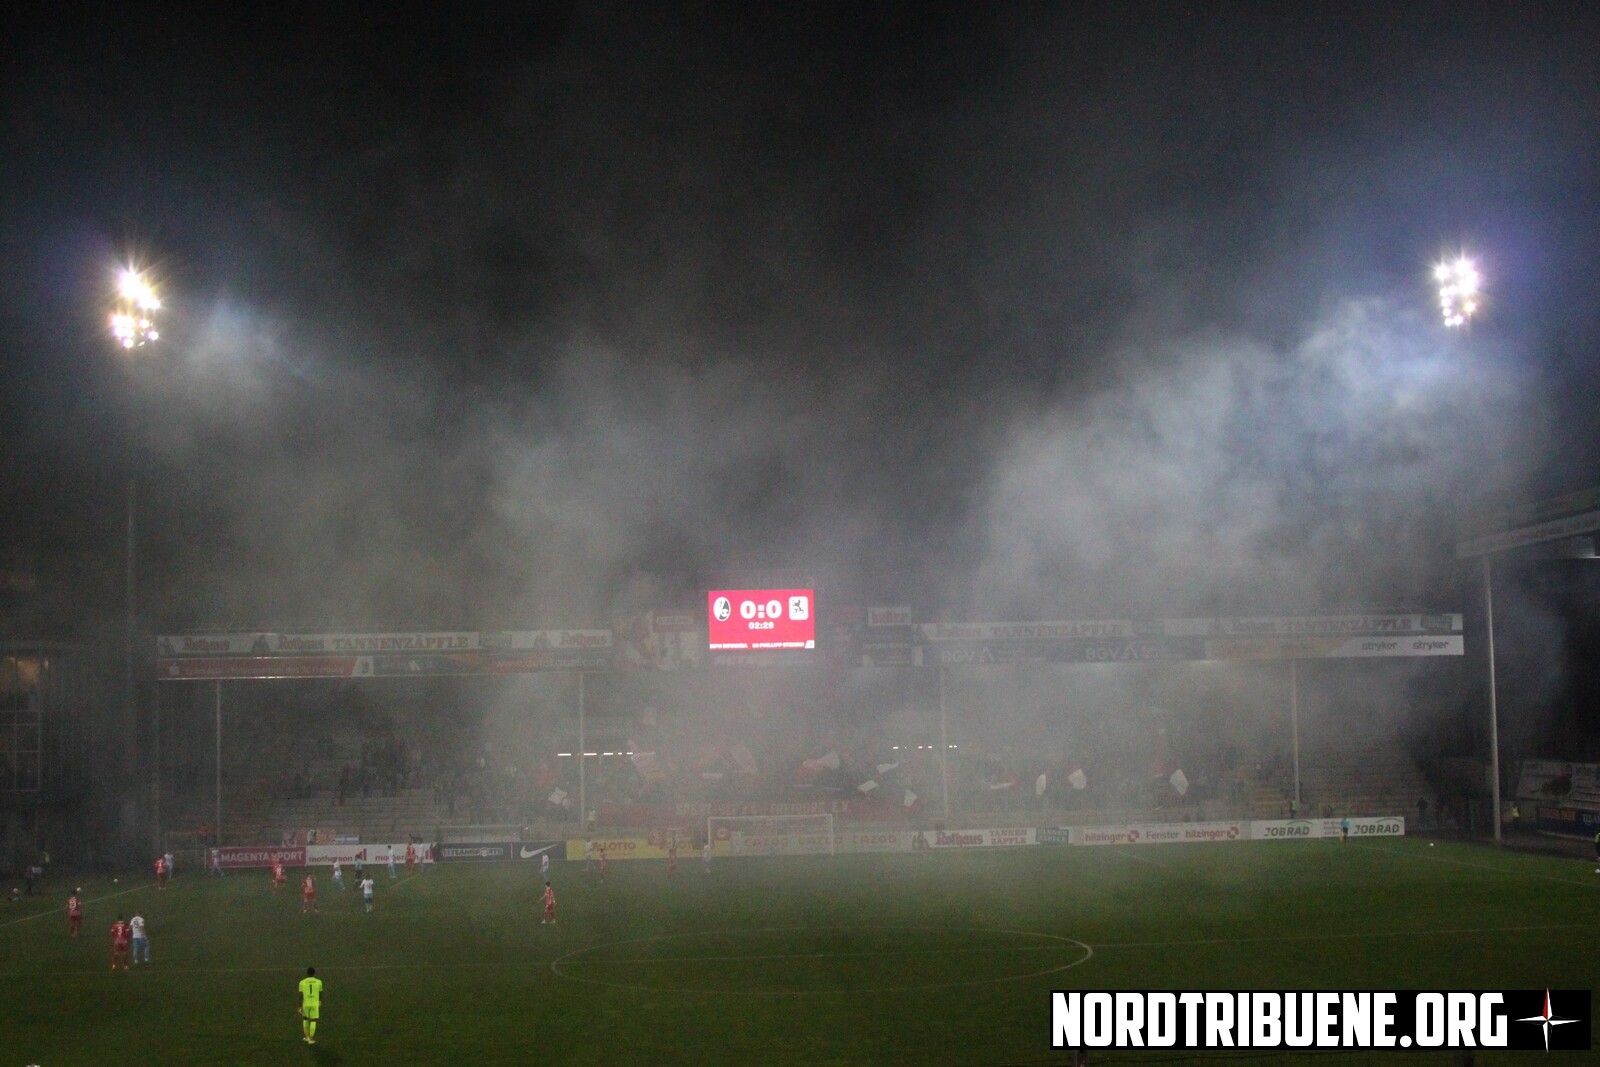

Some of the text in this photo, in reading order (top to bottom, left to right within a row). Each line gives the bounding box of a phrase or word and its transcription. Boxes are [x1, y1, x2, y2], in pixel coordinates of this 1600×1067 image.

[740, 600, 782, 619] 0:0
[333, 635, 468, 649] TANNENZÄPFLE
[1360, 641, 1397, 653] stryker
[1411, 639, 1448, 652] stryker
[942, 650, 974, 663] BGV
[1085, 647, 1120, 661] BGV
[1146, 831, 1180, 840] Fenster
[1184, 828, 1226, 840] hilzinger
[1264, 826, 1310, 837] JOBRAD
[1353, 824, 1400, 835] JOBRAD
[935, 831, 984, 847] Rothaus
[1085, 832, 1127, 843] hilzinger
[604, 841, 637, 851] LOTTO
[221, 851, 304, 863] MAGENTA PORT
[308, 853, 353, 863] motherson
[309, 983, 313, 995] 1
